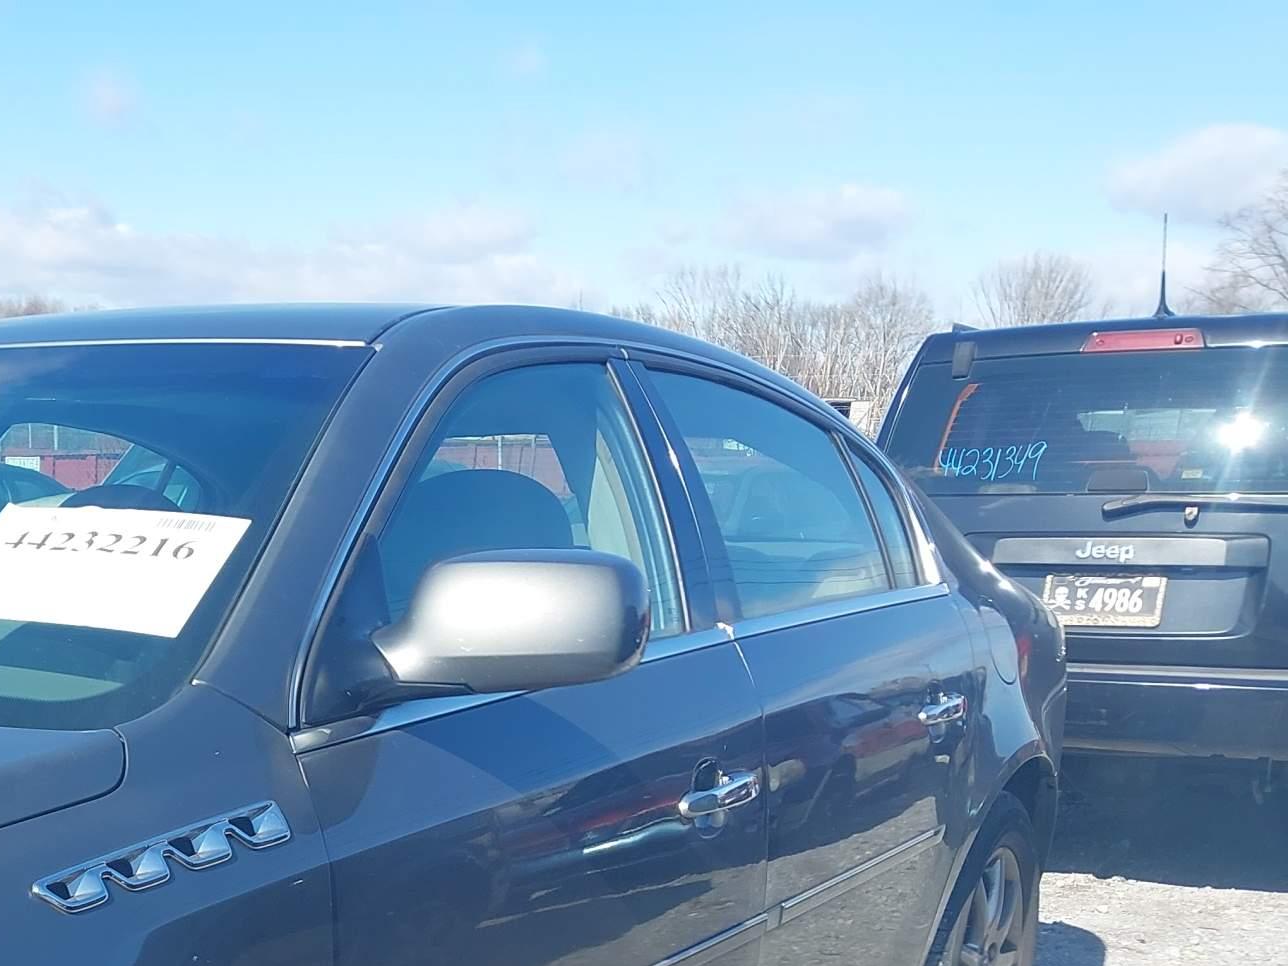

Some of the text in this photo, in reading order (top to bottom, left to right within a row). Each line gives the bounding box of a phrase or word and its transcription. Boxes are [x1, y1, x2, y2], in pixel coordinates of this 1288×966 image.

[939, 441, 1047, 480] 44231349
[3, 530, 198, 560] 44232216
[1074, 540, 1134, 562] Jeep
[1089, 587, 1143, 612] 4986
